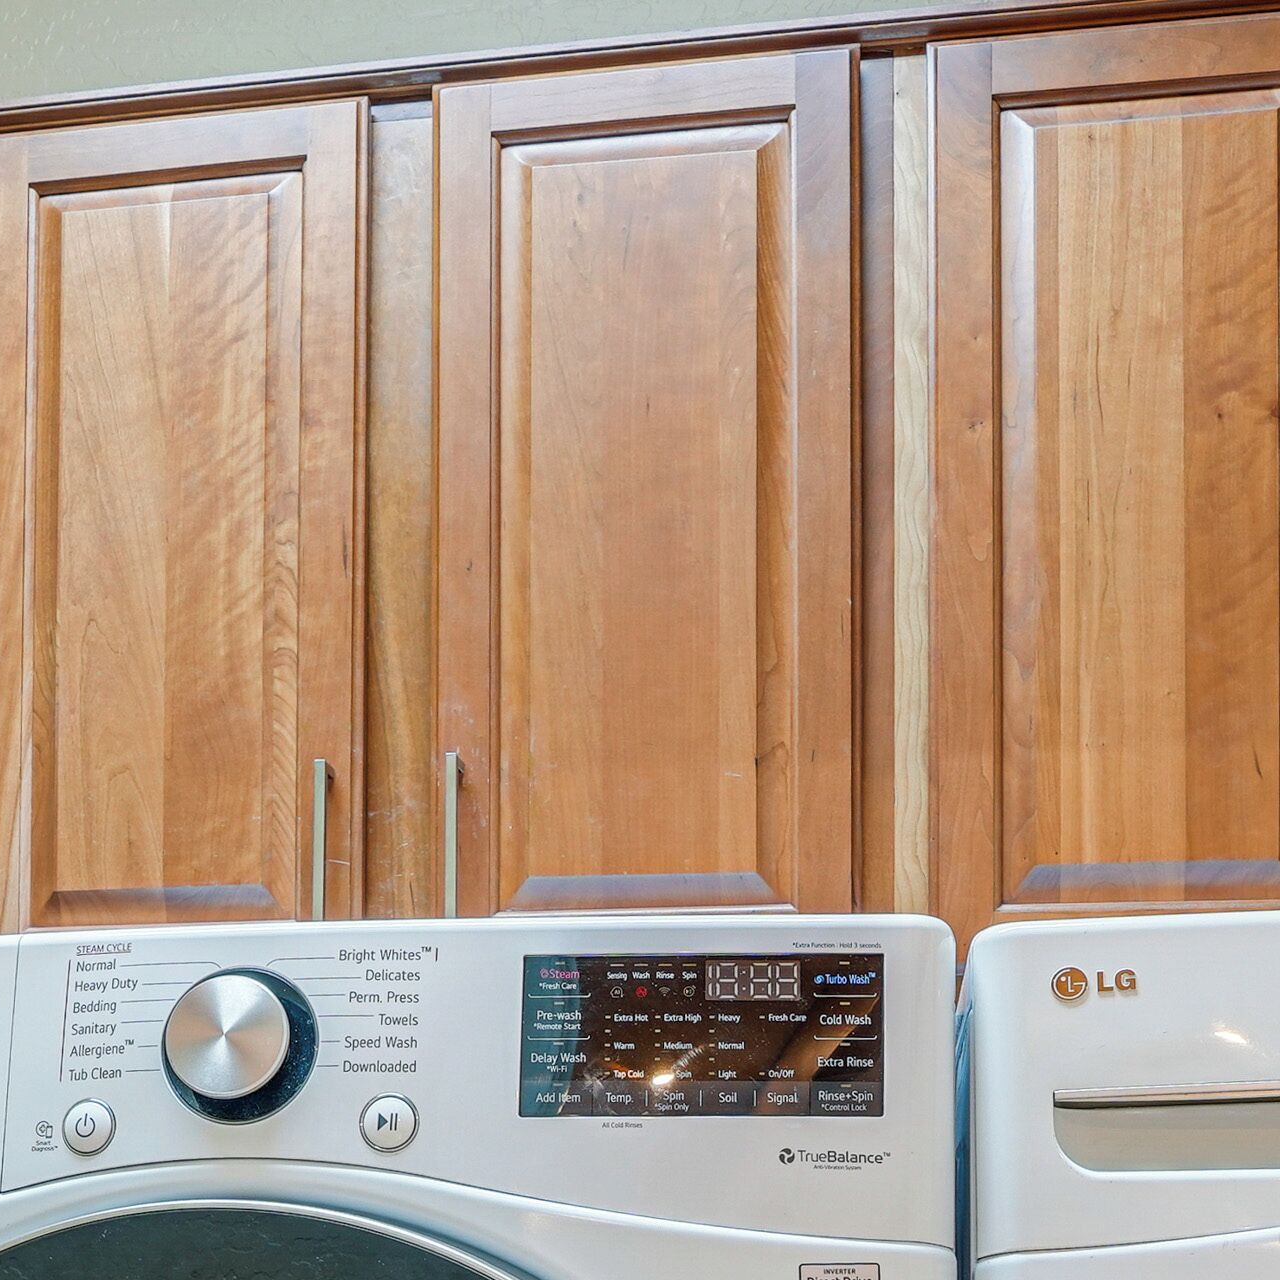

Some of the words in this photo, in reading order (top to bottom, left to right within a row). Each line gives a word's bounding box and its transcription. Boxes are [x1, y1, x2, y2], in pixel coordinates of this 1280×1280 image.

[76, 945, 104, 954] STEAM
[106, 943, 132, 953] CYCLE
[339, 949, 376, 964] Bright
[76, 959, 116, 972] Normal
[365, 969, 420, 981] Delicates
[549, 968, 580, 979] Steam
[682, 972, 697, 980] Spin
[74, 980, 108, 993] Heavy
[111, 977, 138, 991] Duty
[1097, 969, 1138, 993] LG
[349, 991, 383, 1003] Perm.
[387, 991, 420, 1003] Press
[73, 1000, 117, 1015] Bedding
[378, 1013, 419, 1026] Towels
[537, 1010, 581, 1020] Pre-wash
[614, 1014, 633, 1022] Extra
[635, 1014, 649, 1022] Hot
[663, 1014, 683, 1022] Extra
[685, 1014, 702, 1023] High
[718, 1014, 741, 1024] Heavy
[768, 1014, 788, 1022] Fresh
[789, 1014, 807, 1022] Care
[820, 1014, 842, 1025] Cold
[845, 1014, 871, 1025] Wash
[71, 1022, 117, 1036] Sanitary
[344, 1036, 381, 1051] Speed
[385, 1036, 418, 1049] Wash
[614, 1042, 635, 1050] Warm
[663, 1042, 693, 1050] Medium
[718, 1042, 744, 1050] Normal
[531, 1053, 558, 1066] Delay
[560, 1053, 587, 1063] Wash
[817, 1056, 844, 1067] Extra
[846, 1057, 874, 1067] Rinse
[342, 1060, 417, 1073] Downloaded
[69, 1068, 87, 1081] Tub
[91, 1067, 122, 1080] Clean
[614, 1070, 626, 1079] Tap
[627, 1070, 644, 1078] Cold
[718, 1071, 737, 1080] Light
[768, 1070, 795, 1079] On/Off
[536, 1092, 556, 1103] Add
[559, 1092, 581, 1103] Item
[605, 1092, 634, 1104] Temp.
[663, 1090, 685, 1103] Spin
[718, 1092, 738, 1103] Soil
[767, 1092, 799, 1106] Signal
[818, 1090, 874, 1103] Rinse+Spin
[851, 1103, 867, 1111] Lock
